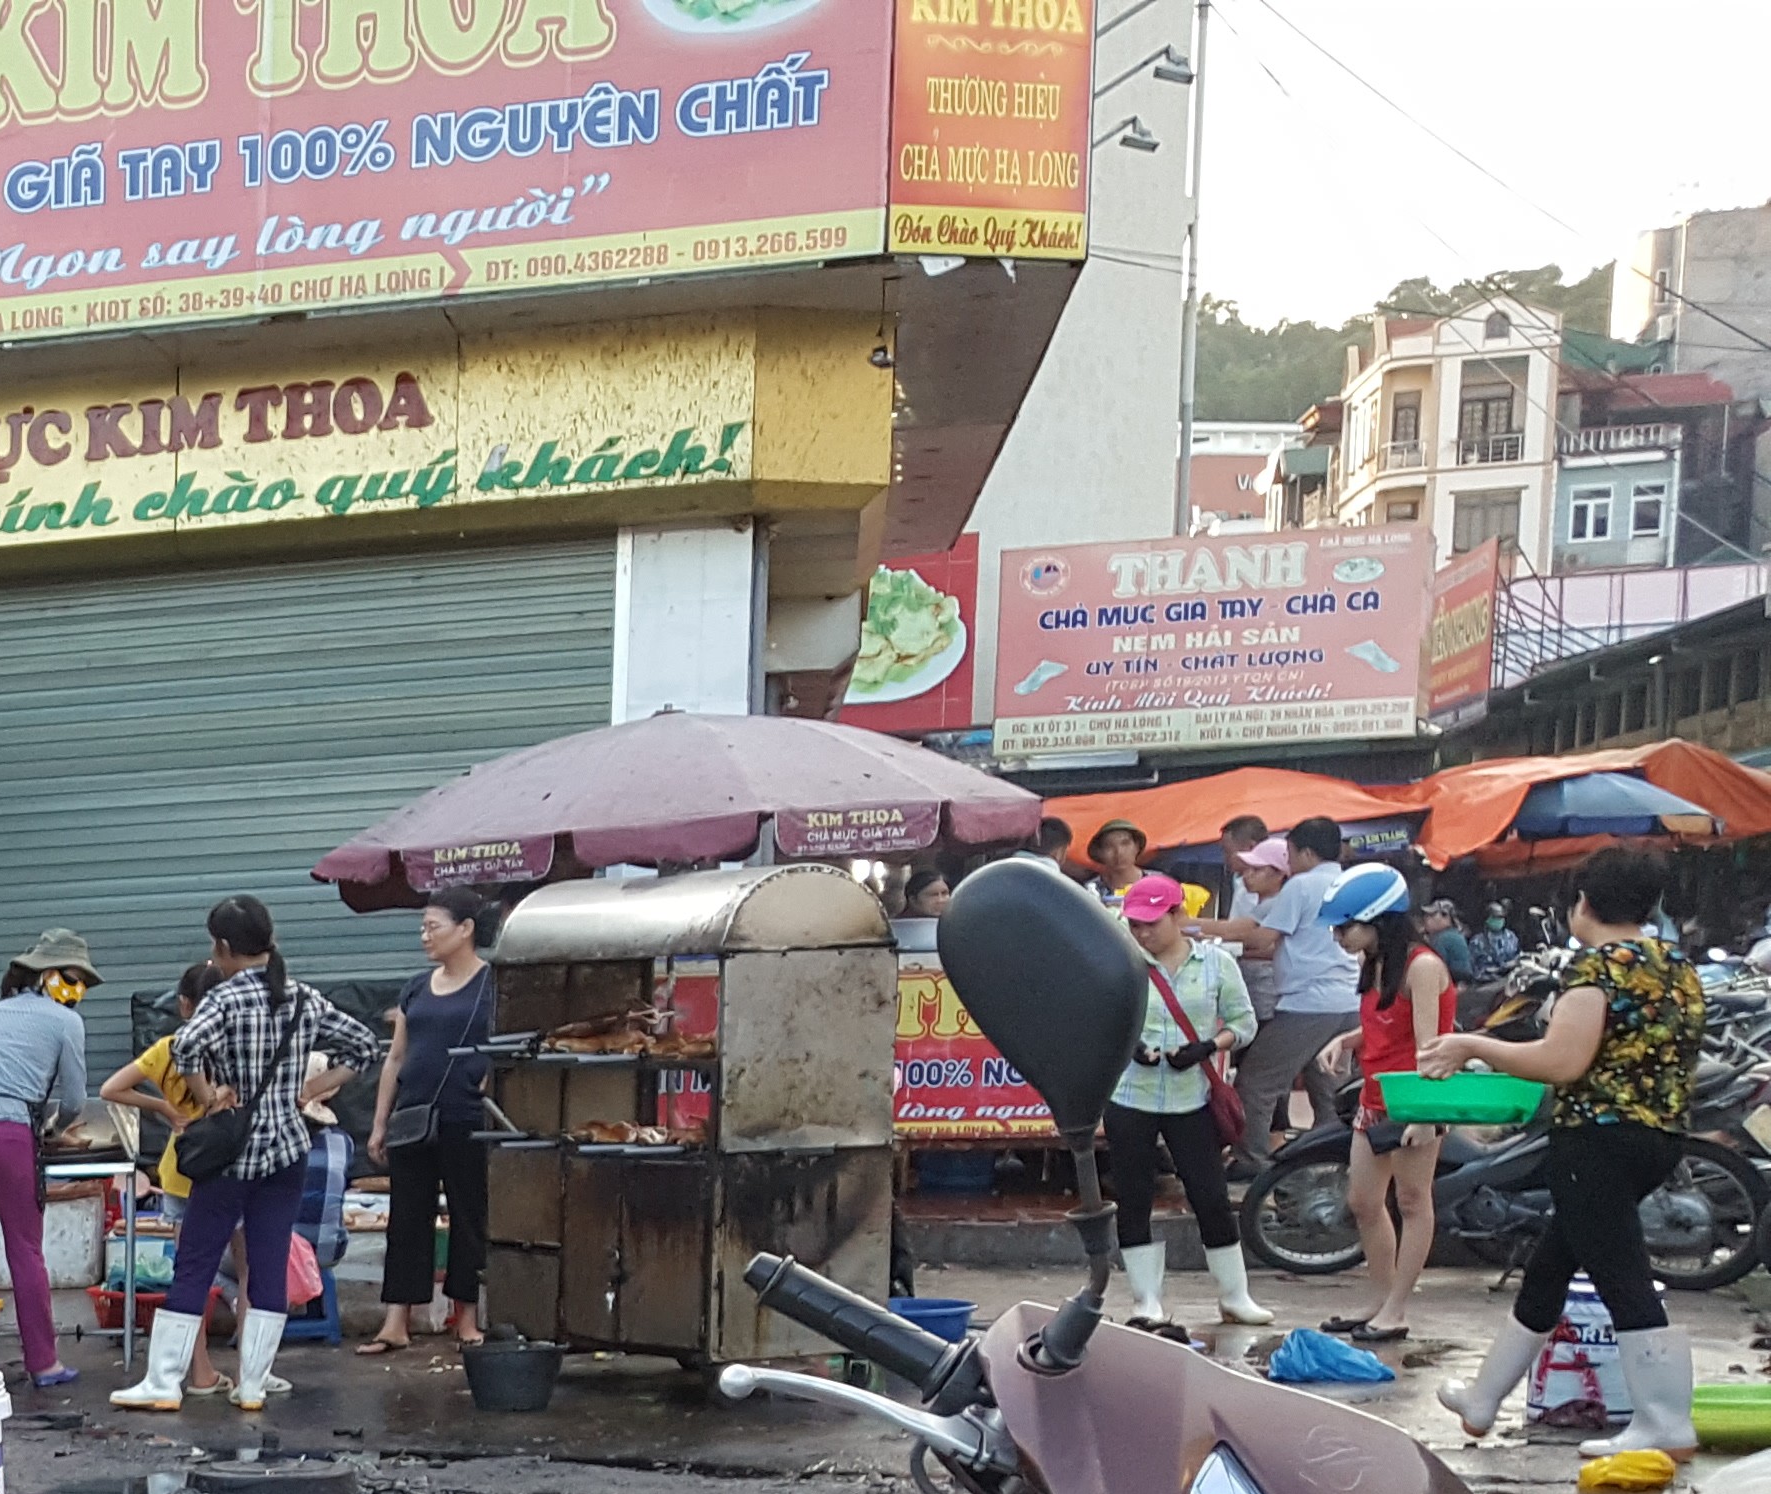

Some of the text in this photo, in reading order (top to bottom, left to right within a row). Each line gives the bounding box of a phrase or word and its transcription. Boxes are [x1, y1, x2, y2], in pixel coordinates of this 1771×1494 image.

[912, 0, 1084, 34] KIM THOA
[233, 0, 617, 99] THOA
[927, 74, 1008, 117] THƯƠNG
[4, 142, 105, 212] GIÃ
[119, 138, 220, 202] TAY
[238, 118, 396, 188] 100%
[411, 81, 661, 169] NGUYÊN
[675, 50, 830, 138] CHẤT
[900, 126, 1079, 194] CHẢ MỰC HẠ LONG
[140, 233, 240, 270] say
[256, 213, 385, 256] lòng
[526, 244, 669, 278] 090.4362288
[692, 226, 848, 264] 0913.266.599
[895, 212, 1082, 253] Đón Chào Quý Khách!
[11, 305, 64, 331] LONG
[179, 283, 283, 313] 38+39+40
[290, 276, 333, 303] CHỢ
[375, 267, 431, 294] LONG
[84, 391, 224, 462] KIM
[236, 370, 435, 444] THOA
[132, 469, 305, 521] chào
[314, 448, 459, 515] quý
[475, 420, 750, 493] khách!
[1107, 541, 1309, 598] THANH
[1218, 597, 1264, 620] TAY
[1112, 621, 1301, 654] NEM HẢI SẢN
[1085, 660, 1114, 676] UY
[1123, 656, 1159, 674] TÍN
[1247, 648, 1325, 669] LƯỢNG
[1064, 696, 1122, 713] Kính
[1183, 687, 1233, 709] Quý
[1245, 682, 1334, 704] Khách!
[807, 811, 844, 828] KIM
[886, 826, 908, 838] TAY
[434, 846, 469, 864] KIM
